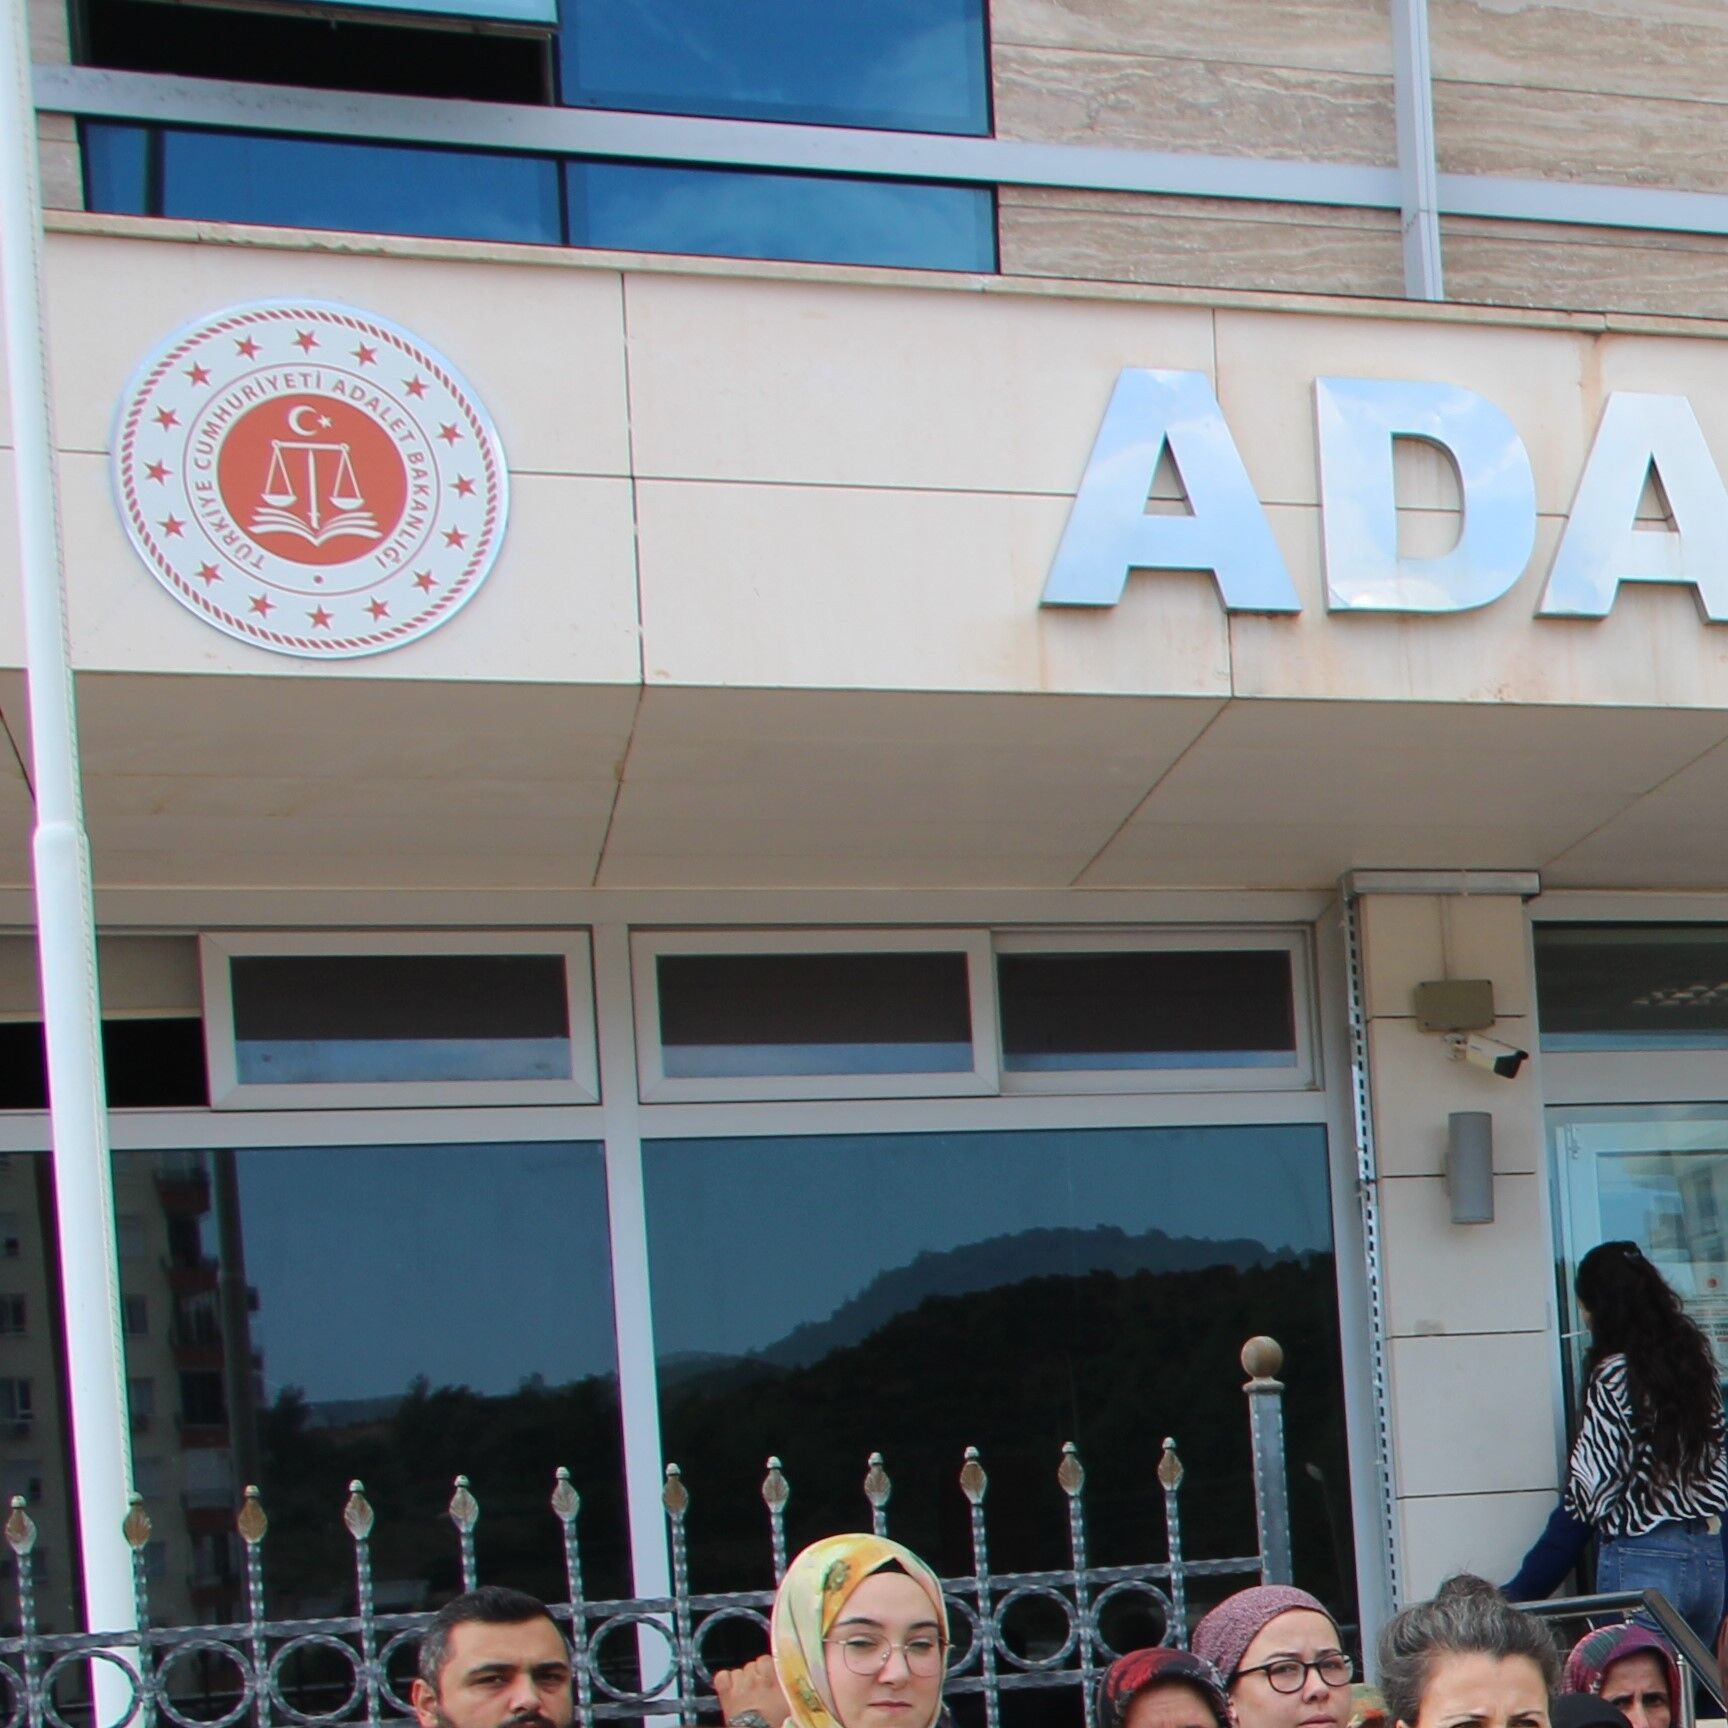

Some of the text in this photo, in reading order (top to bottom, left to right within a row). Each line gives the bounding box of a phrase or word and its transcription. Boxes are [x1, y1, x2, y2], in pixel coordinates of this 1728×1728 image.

[194, 370, 431, 570] TÜRKİYE CUMHURİYETİ ADALET BAKANLIĞI
